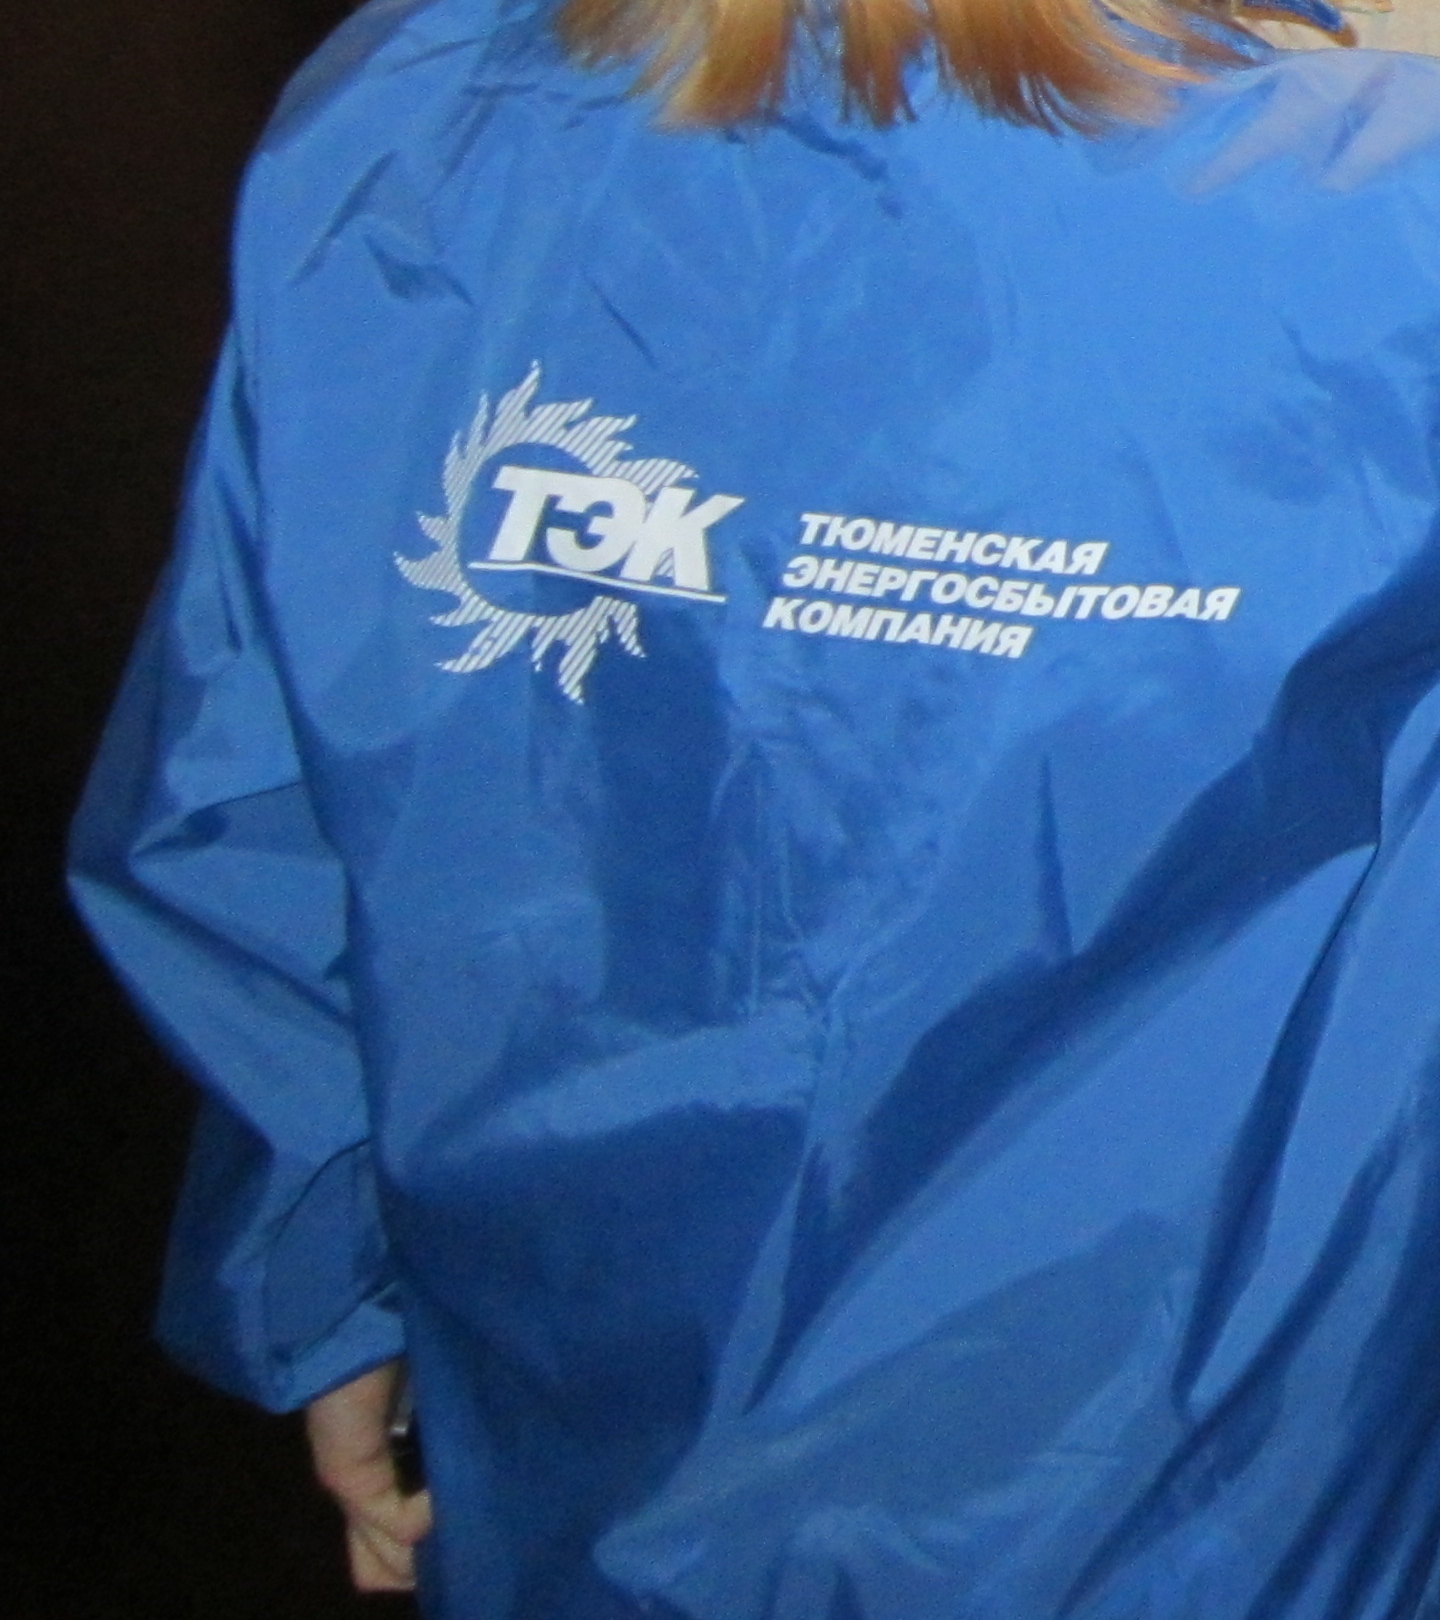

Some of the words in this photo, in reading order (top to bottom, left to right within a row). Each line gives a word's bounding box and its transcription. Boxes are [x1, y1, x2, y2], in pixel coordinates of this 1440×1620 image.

[485, 465, 745, 592] ТЭК
[798, 512, 1108, 577] ТЮМЕНСКАЯ
[782, 556, 1241, 622] ЭНЕРГОСБЫТОВАЯ
[762, 598, 1033, 659] КОМПАНИЯ
